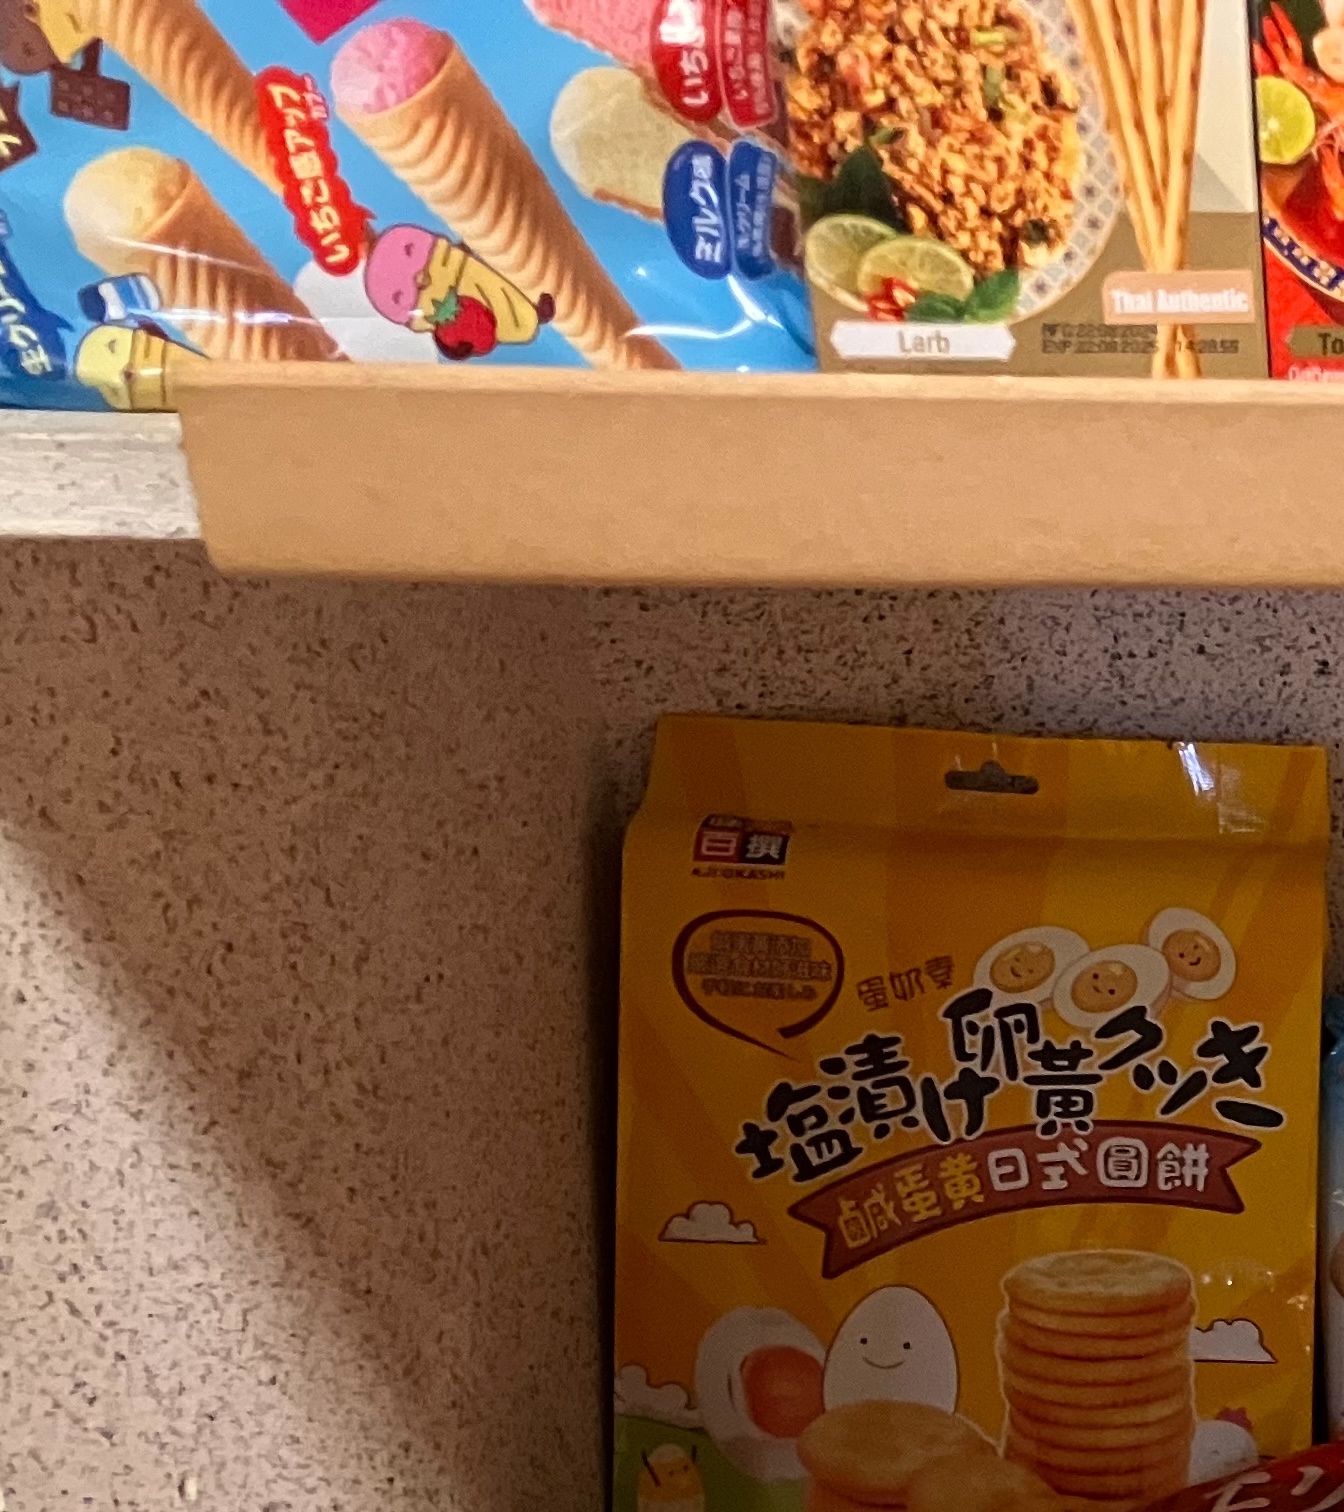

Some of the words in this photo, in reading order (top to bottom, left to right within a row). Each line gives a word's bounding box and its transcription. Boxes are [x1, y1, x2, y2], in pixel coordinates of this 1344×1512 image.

[1111, 289, 1152, 313] Thai
[1157, 289, 1249, 313] Authentic
[899, 331, 951, 354] Larb
